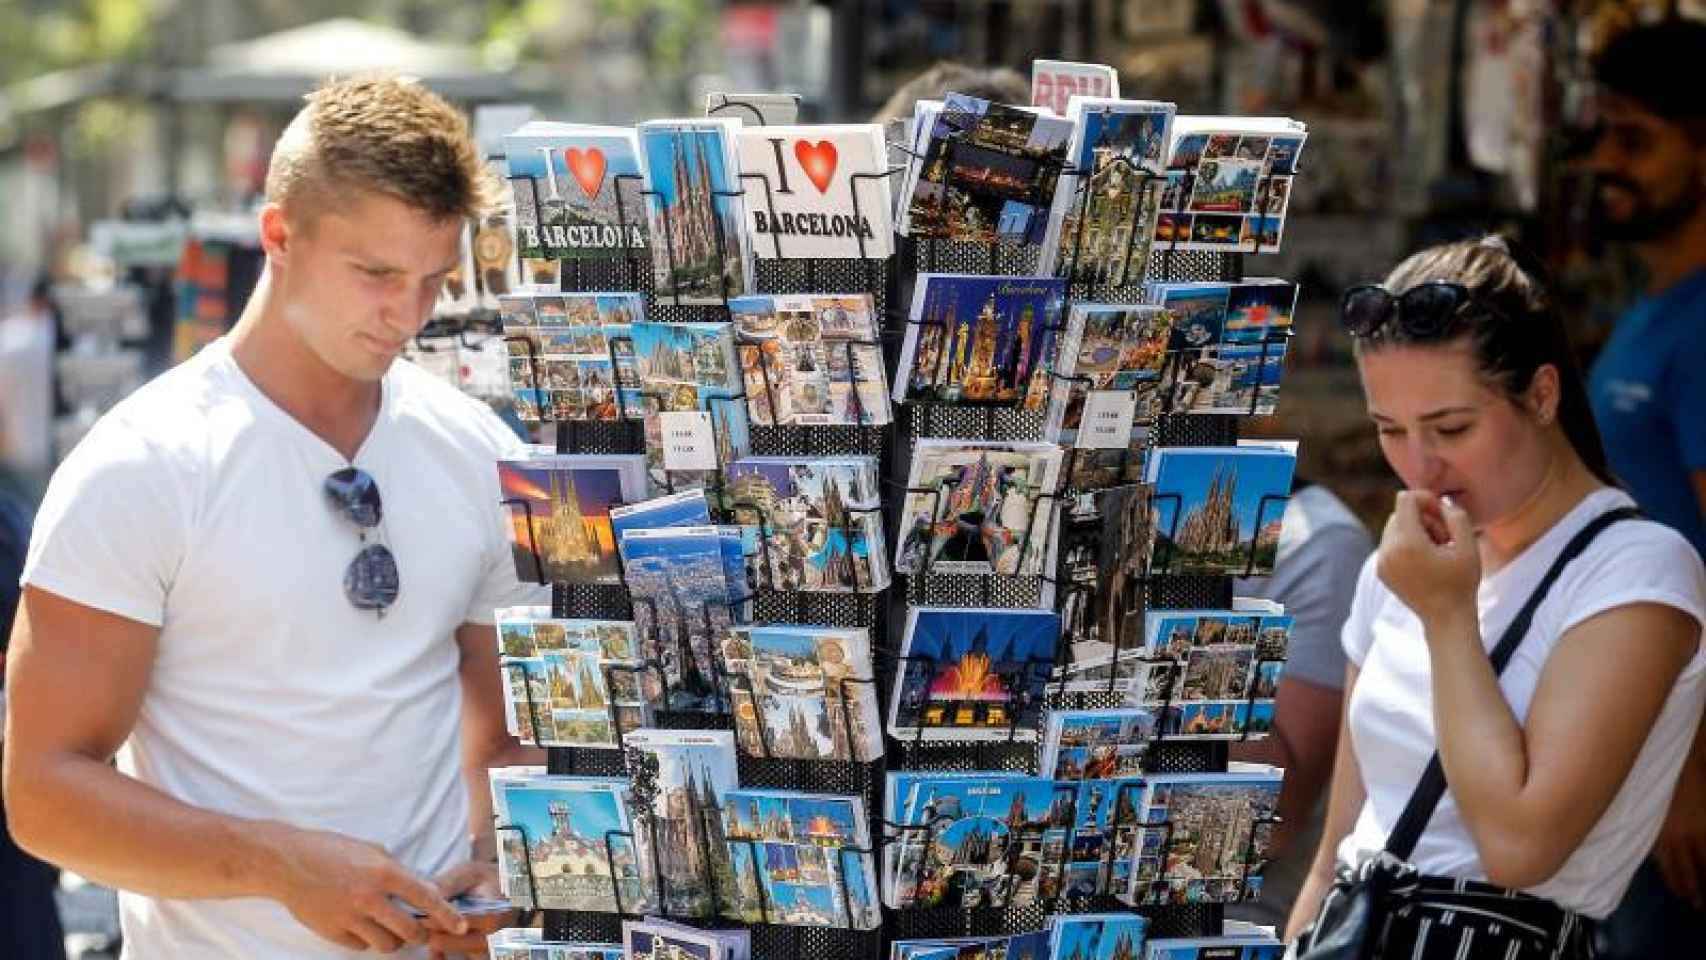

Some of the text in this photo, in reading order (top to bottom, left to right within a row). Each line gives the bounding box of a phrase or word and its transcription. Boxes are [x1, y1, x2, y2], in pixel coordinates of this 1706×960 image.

[536, 147, 562, 200] I
[767, 138, 794, 194] I
[753, 210, 873, 239] BARCELONA
